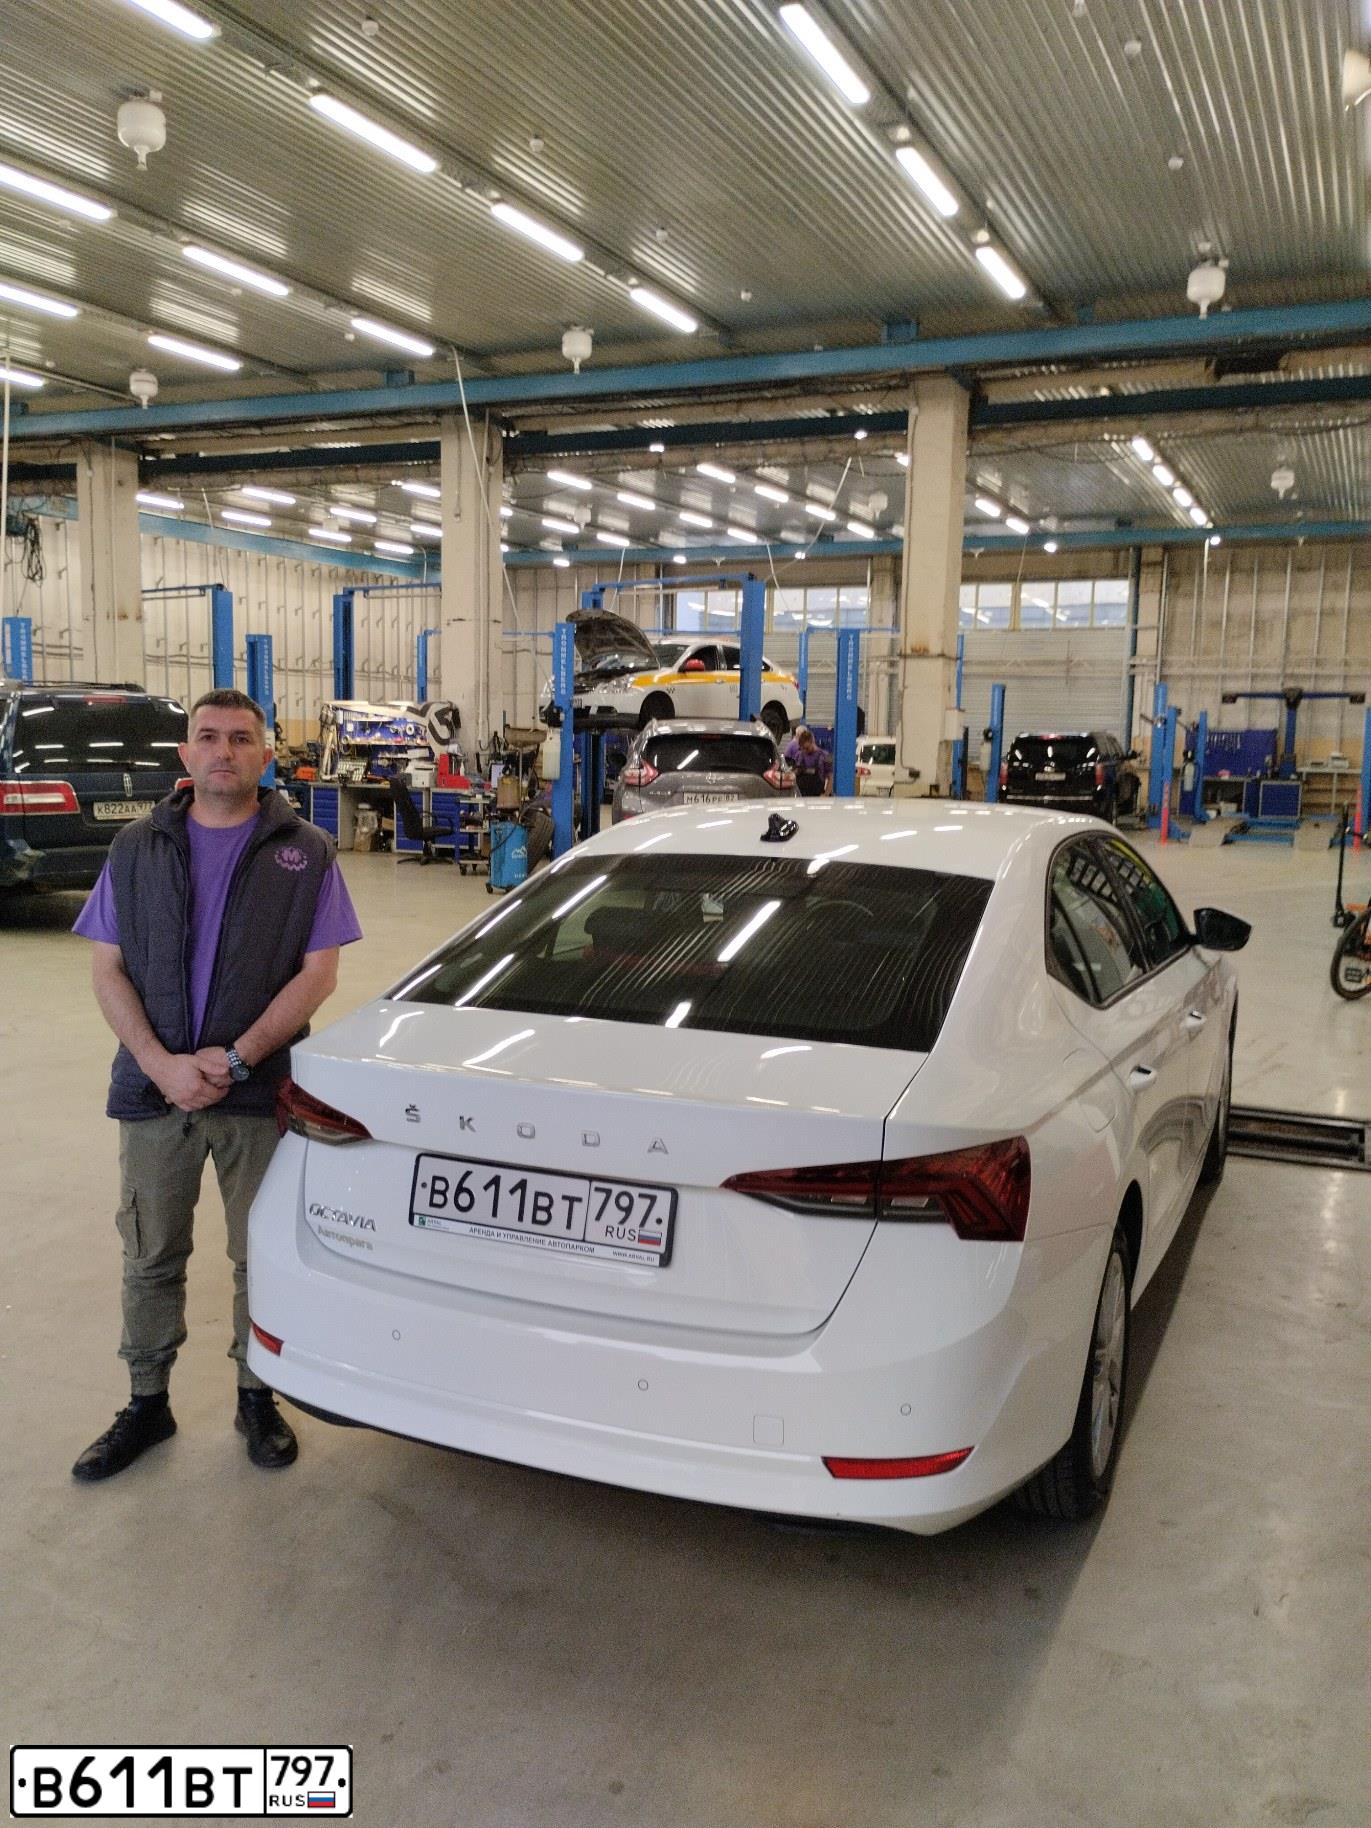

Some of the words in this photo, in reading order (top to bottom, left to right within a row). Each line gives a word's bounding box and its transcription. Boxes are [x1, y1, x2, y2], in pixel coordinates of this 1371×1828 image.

[428, 1171, 583, 1230] В611ВТ
[594, 1187, 658, 1228] 797
[309, 1203, 377, 1232] OCTAVIA
[469, 1226, 495, 1238] АРЕНДА
[502, 1232, 546, 1246] УПРАВЛЕНИЕ
[547, 1240, 595, 1254] АВТОПАРКОМ
[605, 1225, 637, 1241] RUS
